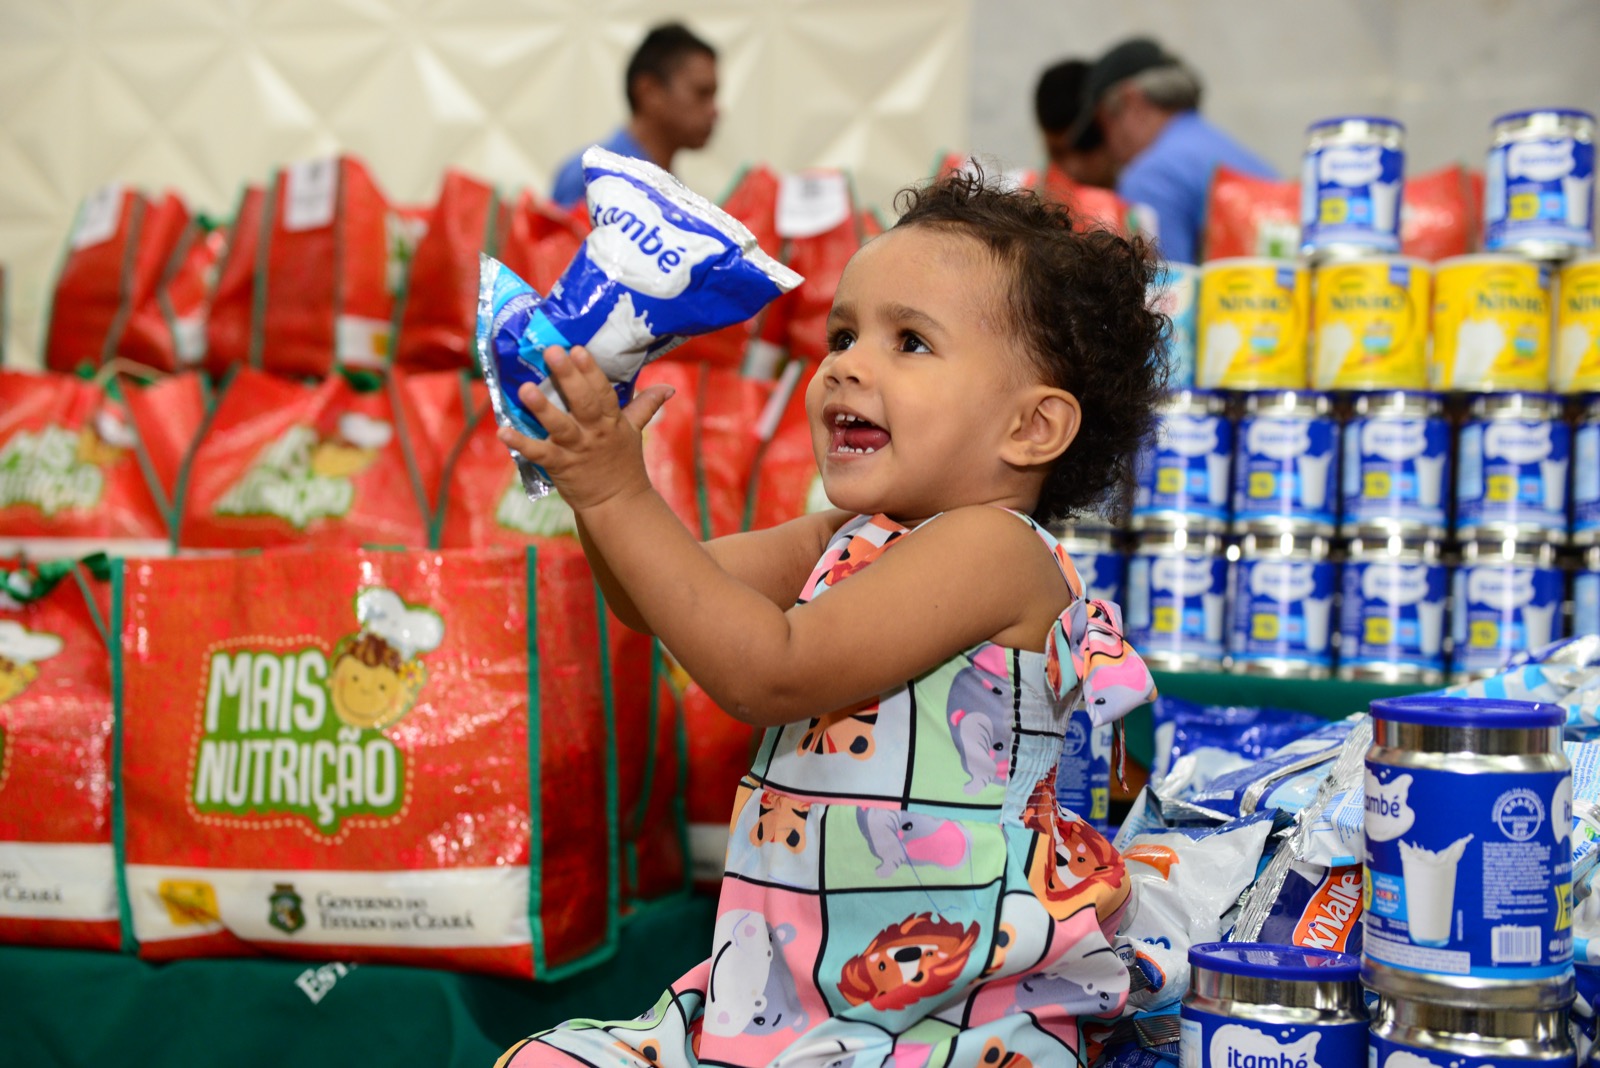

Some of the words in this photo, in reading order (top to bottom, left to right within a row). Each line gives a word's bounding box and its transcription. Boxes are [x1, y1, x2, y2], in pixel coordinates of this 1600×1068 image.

[590, 200, 688, 274] també
[206, 650, 328, 734] MAIS
[195, 726, 397, 826] NUTRIÇÃO
[1227, 1046, 1309, 1068] itambé
